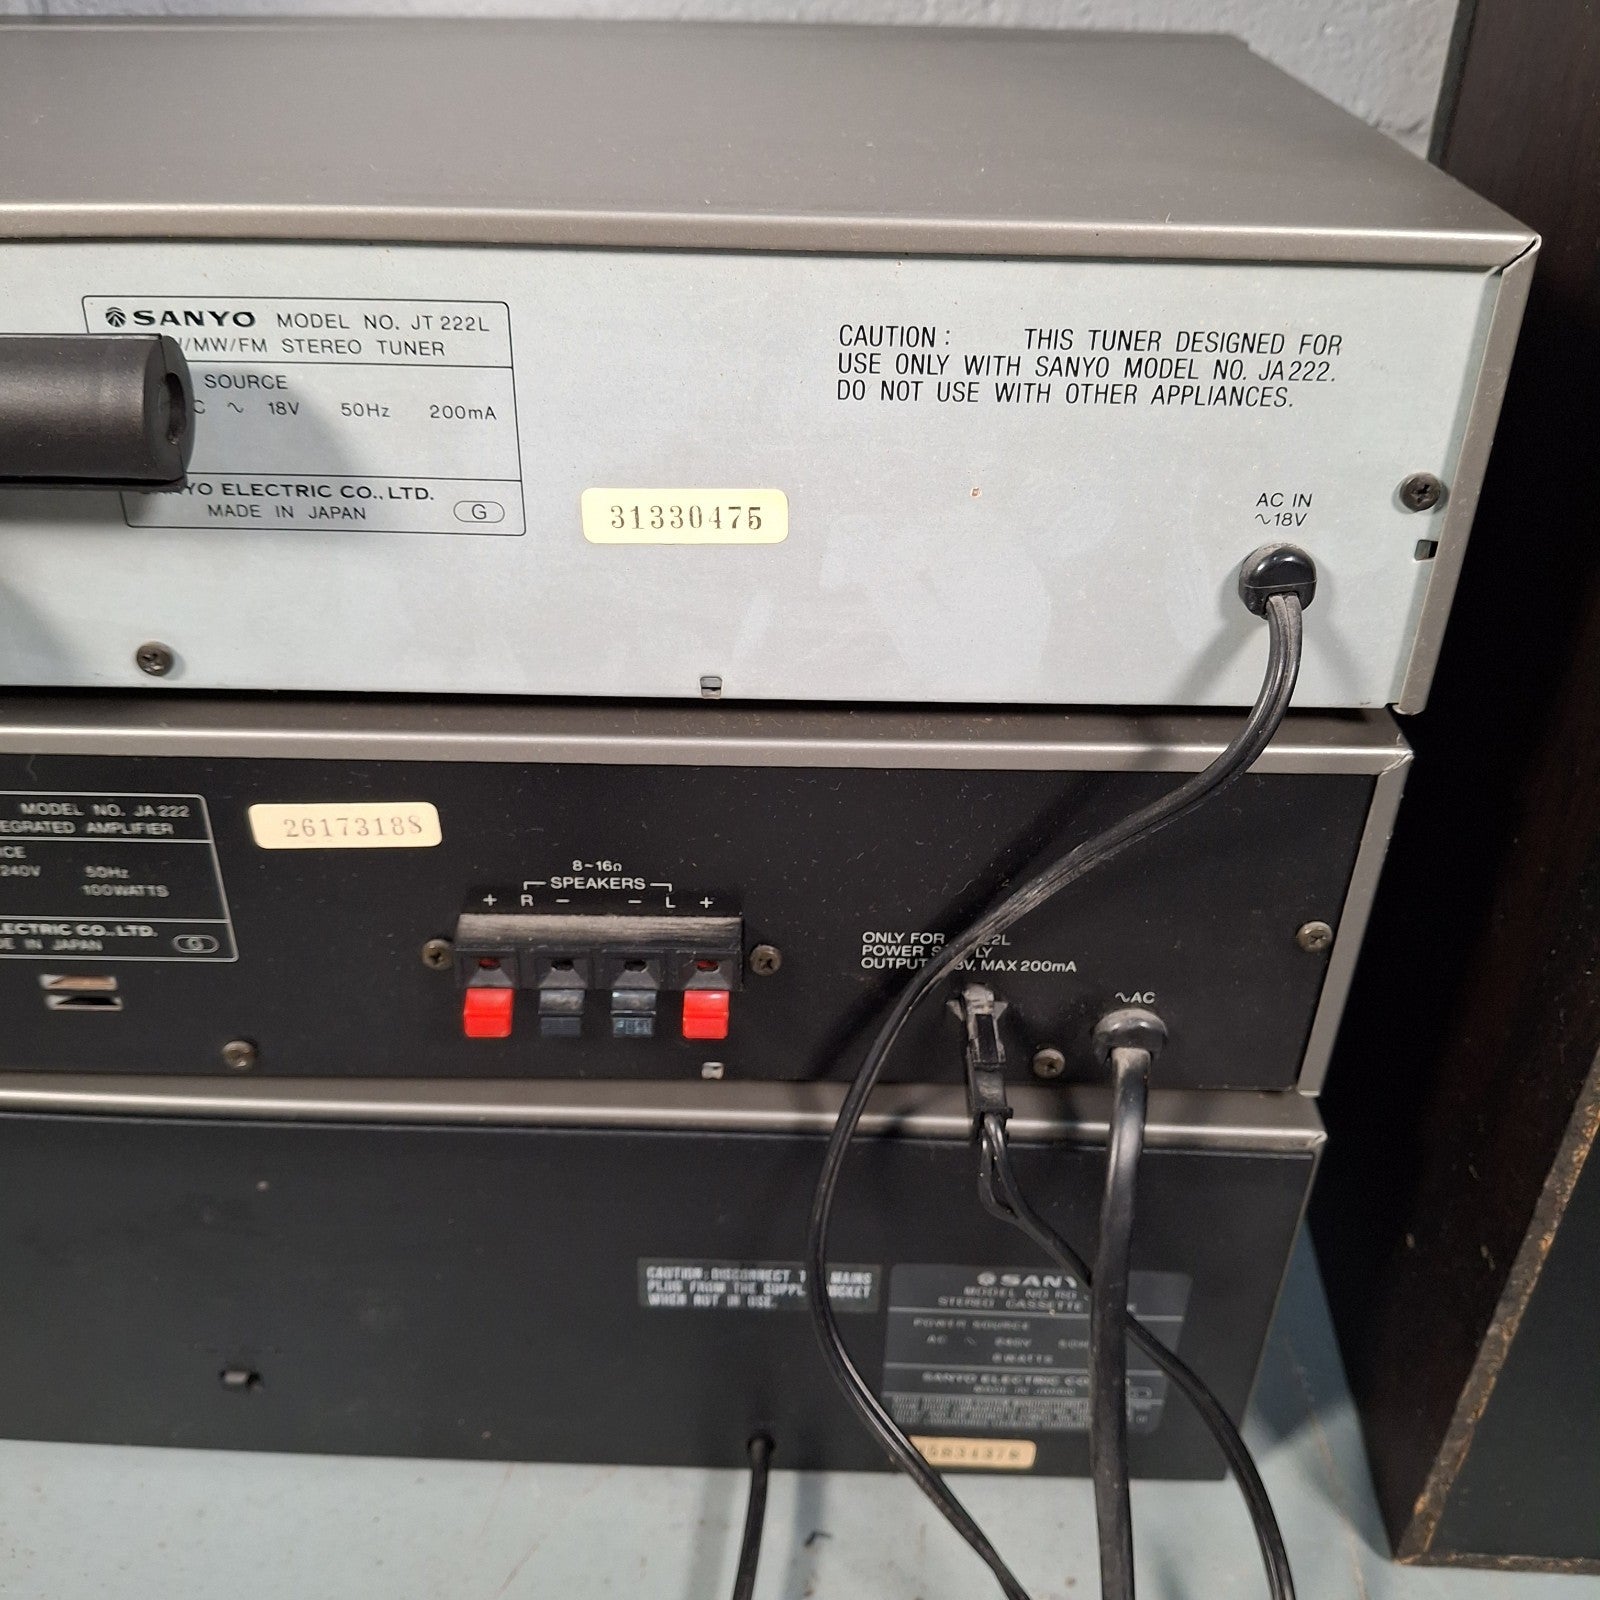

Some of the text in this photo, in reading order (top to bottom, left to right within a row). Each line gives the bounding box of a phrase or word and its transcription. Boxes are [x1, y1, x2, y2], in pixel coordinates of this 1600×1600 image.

[133, 310, 256, 328] SANYO
[277, 313, 350, 330] MODEL
[364, 314, 400, 331] NO.
[282, 340, 362, 355] STEREO
[377, 341, 446, 356] TUNER
[1025, 329, 1073, 350] THIS
[1088, 330, 1161, 351] TUNER
[1176, 331, 1285, 354] DESIGNED
[1299, 334, 1342, 355] FOR
[838, 353, 881, 374] USE
[896, 354, 950, 375] ONLY
[964, 355, 1021, 376] WITH
[1035, 356, 1109, 377] SANYO
[1124, 358, 1199, 379] MODEL
[1213, 359, 1247, 380] NO.
[204, 374, 288, 391] SOURCE
[837, 380, 1293, 407] DO NOT USE WITH OTHER APPLIANCES.
[268, 402, 299, 416] 18V
[341, 403, 391, 418] 50Hz
[429, 405, 497, 420] 200mA
[222, 483, 331, 498] ELECTRIC
[1256, 493, 1312, 507] AC IN
[208, 504, 366, 521] MADE IN JAPAN
[472, 504, 487, 520] G
[611, 505, 762, 530] 31330475
[20, 803, 85, 816] MODEL
[93, 803, 126, 817] NO.
[85, 865, 130, 878] 50Hz
[550, 877, 646, 890] SPEAKERS
[520, 894, 534, 907] R
[665, 896, 676, 908] L
[862, 932, 903, 944] ONLY
[910, 932, 945, 945] FOR
[862, 945, 924, 957] POWER
[981, 960, 1018, 972] MAX
[1020, 960, 1078, 973] 200mA
